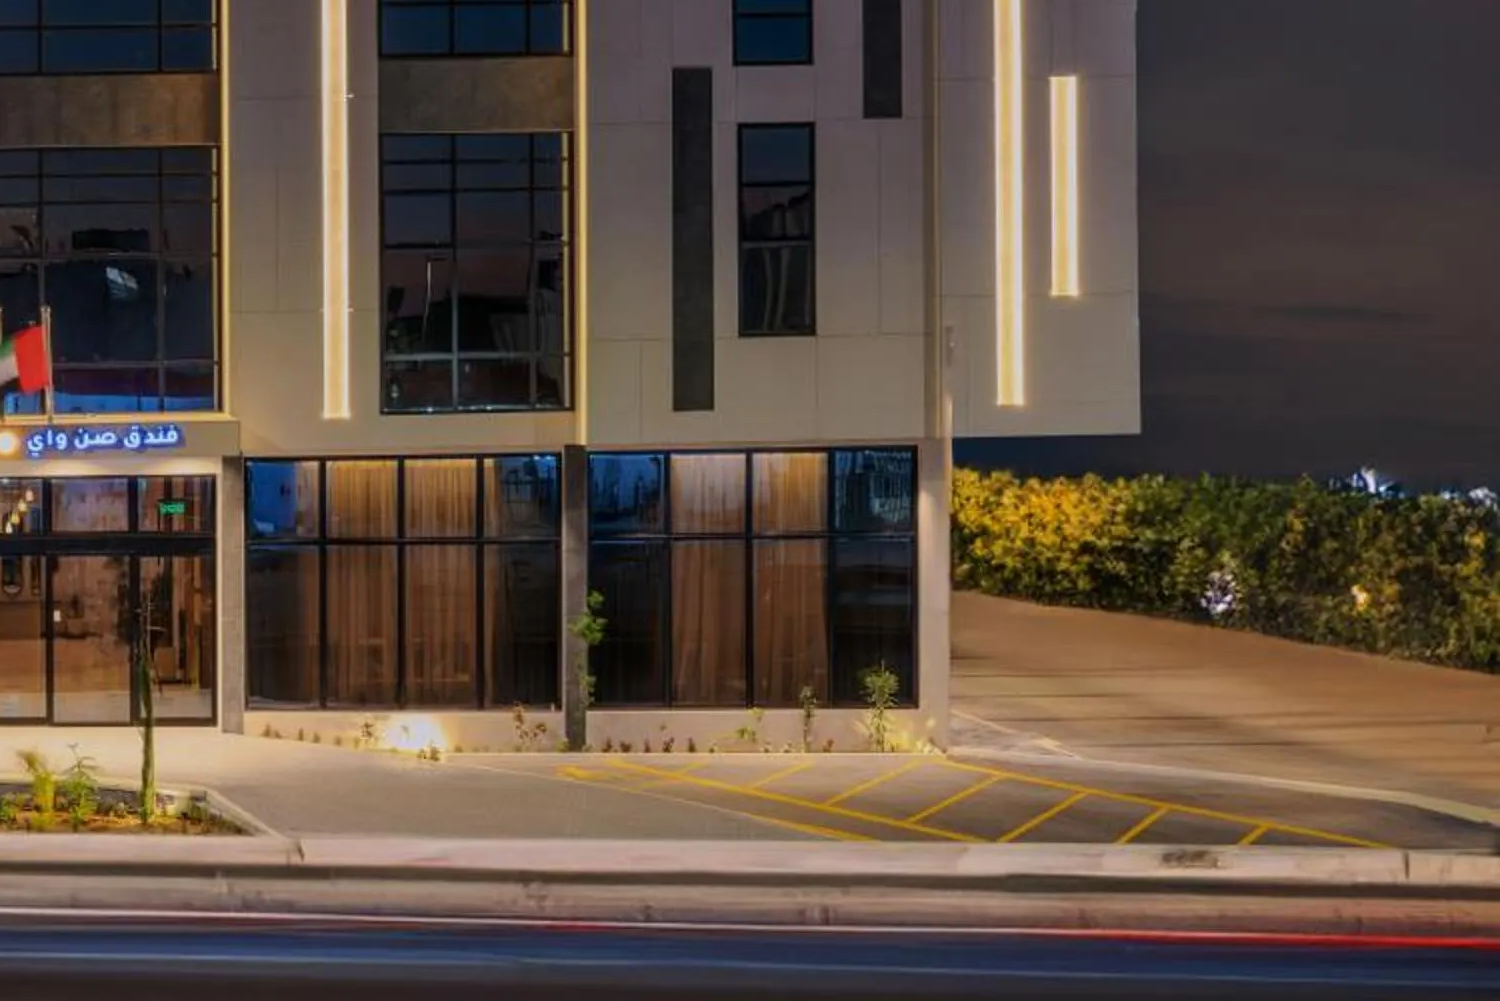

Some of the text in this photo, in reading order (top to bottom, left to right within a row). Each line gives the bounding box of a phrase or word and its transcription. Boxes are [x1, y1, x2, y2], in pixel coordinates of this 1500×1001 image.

[27, 423, 179, 457] فندق صن واي
